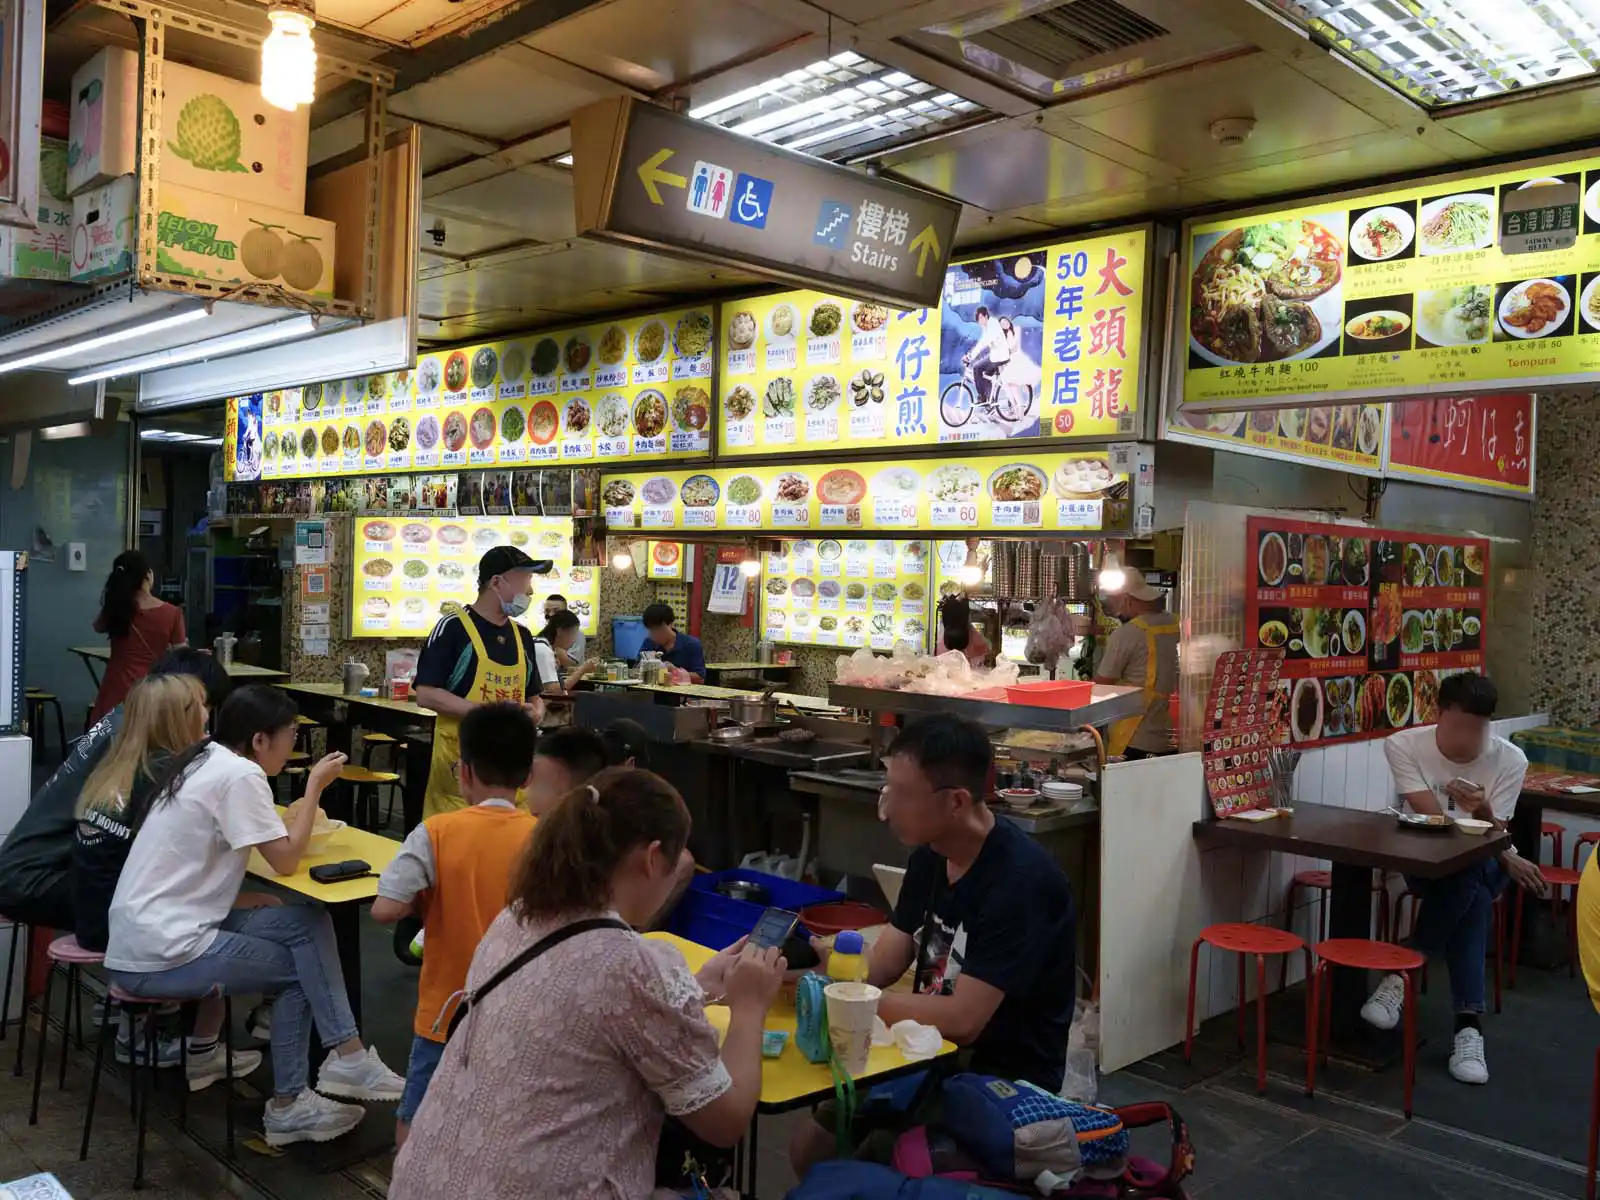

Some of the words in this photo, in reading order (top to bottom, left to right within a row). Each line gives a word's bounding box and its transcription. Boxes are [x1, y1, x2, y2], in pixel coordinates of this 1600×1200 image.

[856, 199, 911, 248] 樓梯
[850, 241, 900, 272] Stairs
[1052, 251, 1088, 405] 50年老店
[1085, 248, 1135, 421] 大頭龍
[1551, 340, 1562, 349] 50
[1507, 356, 1557, 369] Tempura
[1219, 363, 1292, 379] 紅燒牛肉麵
[1299, 362, 1319, 373] 100
[1056, 414, 1072, 428] 50
[616, 441, 626, 451] 60
[703, 510, 716, 523] 80
[795, 508, 809, 522] 30
[901, 505, 916, 518] 60
[960, 507, 976, 521] 60
[721, 566, 740, 590] 12
[97, 814, 131, 840] MOUNT
